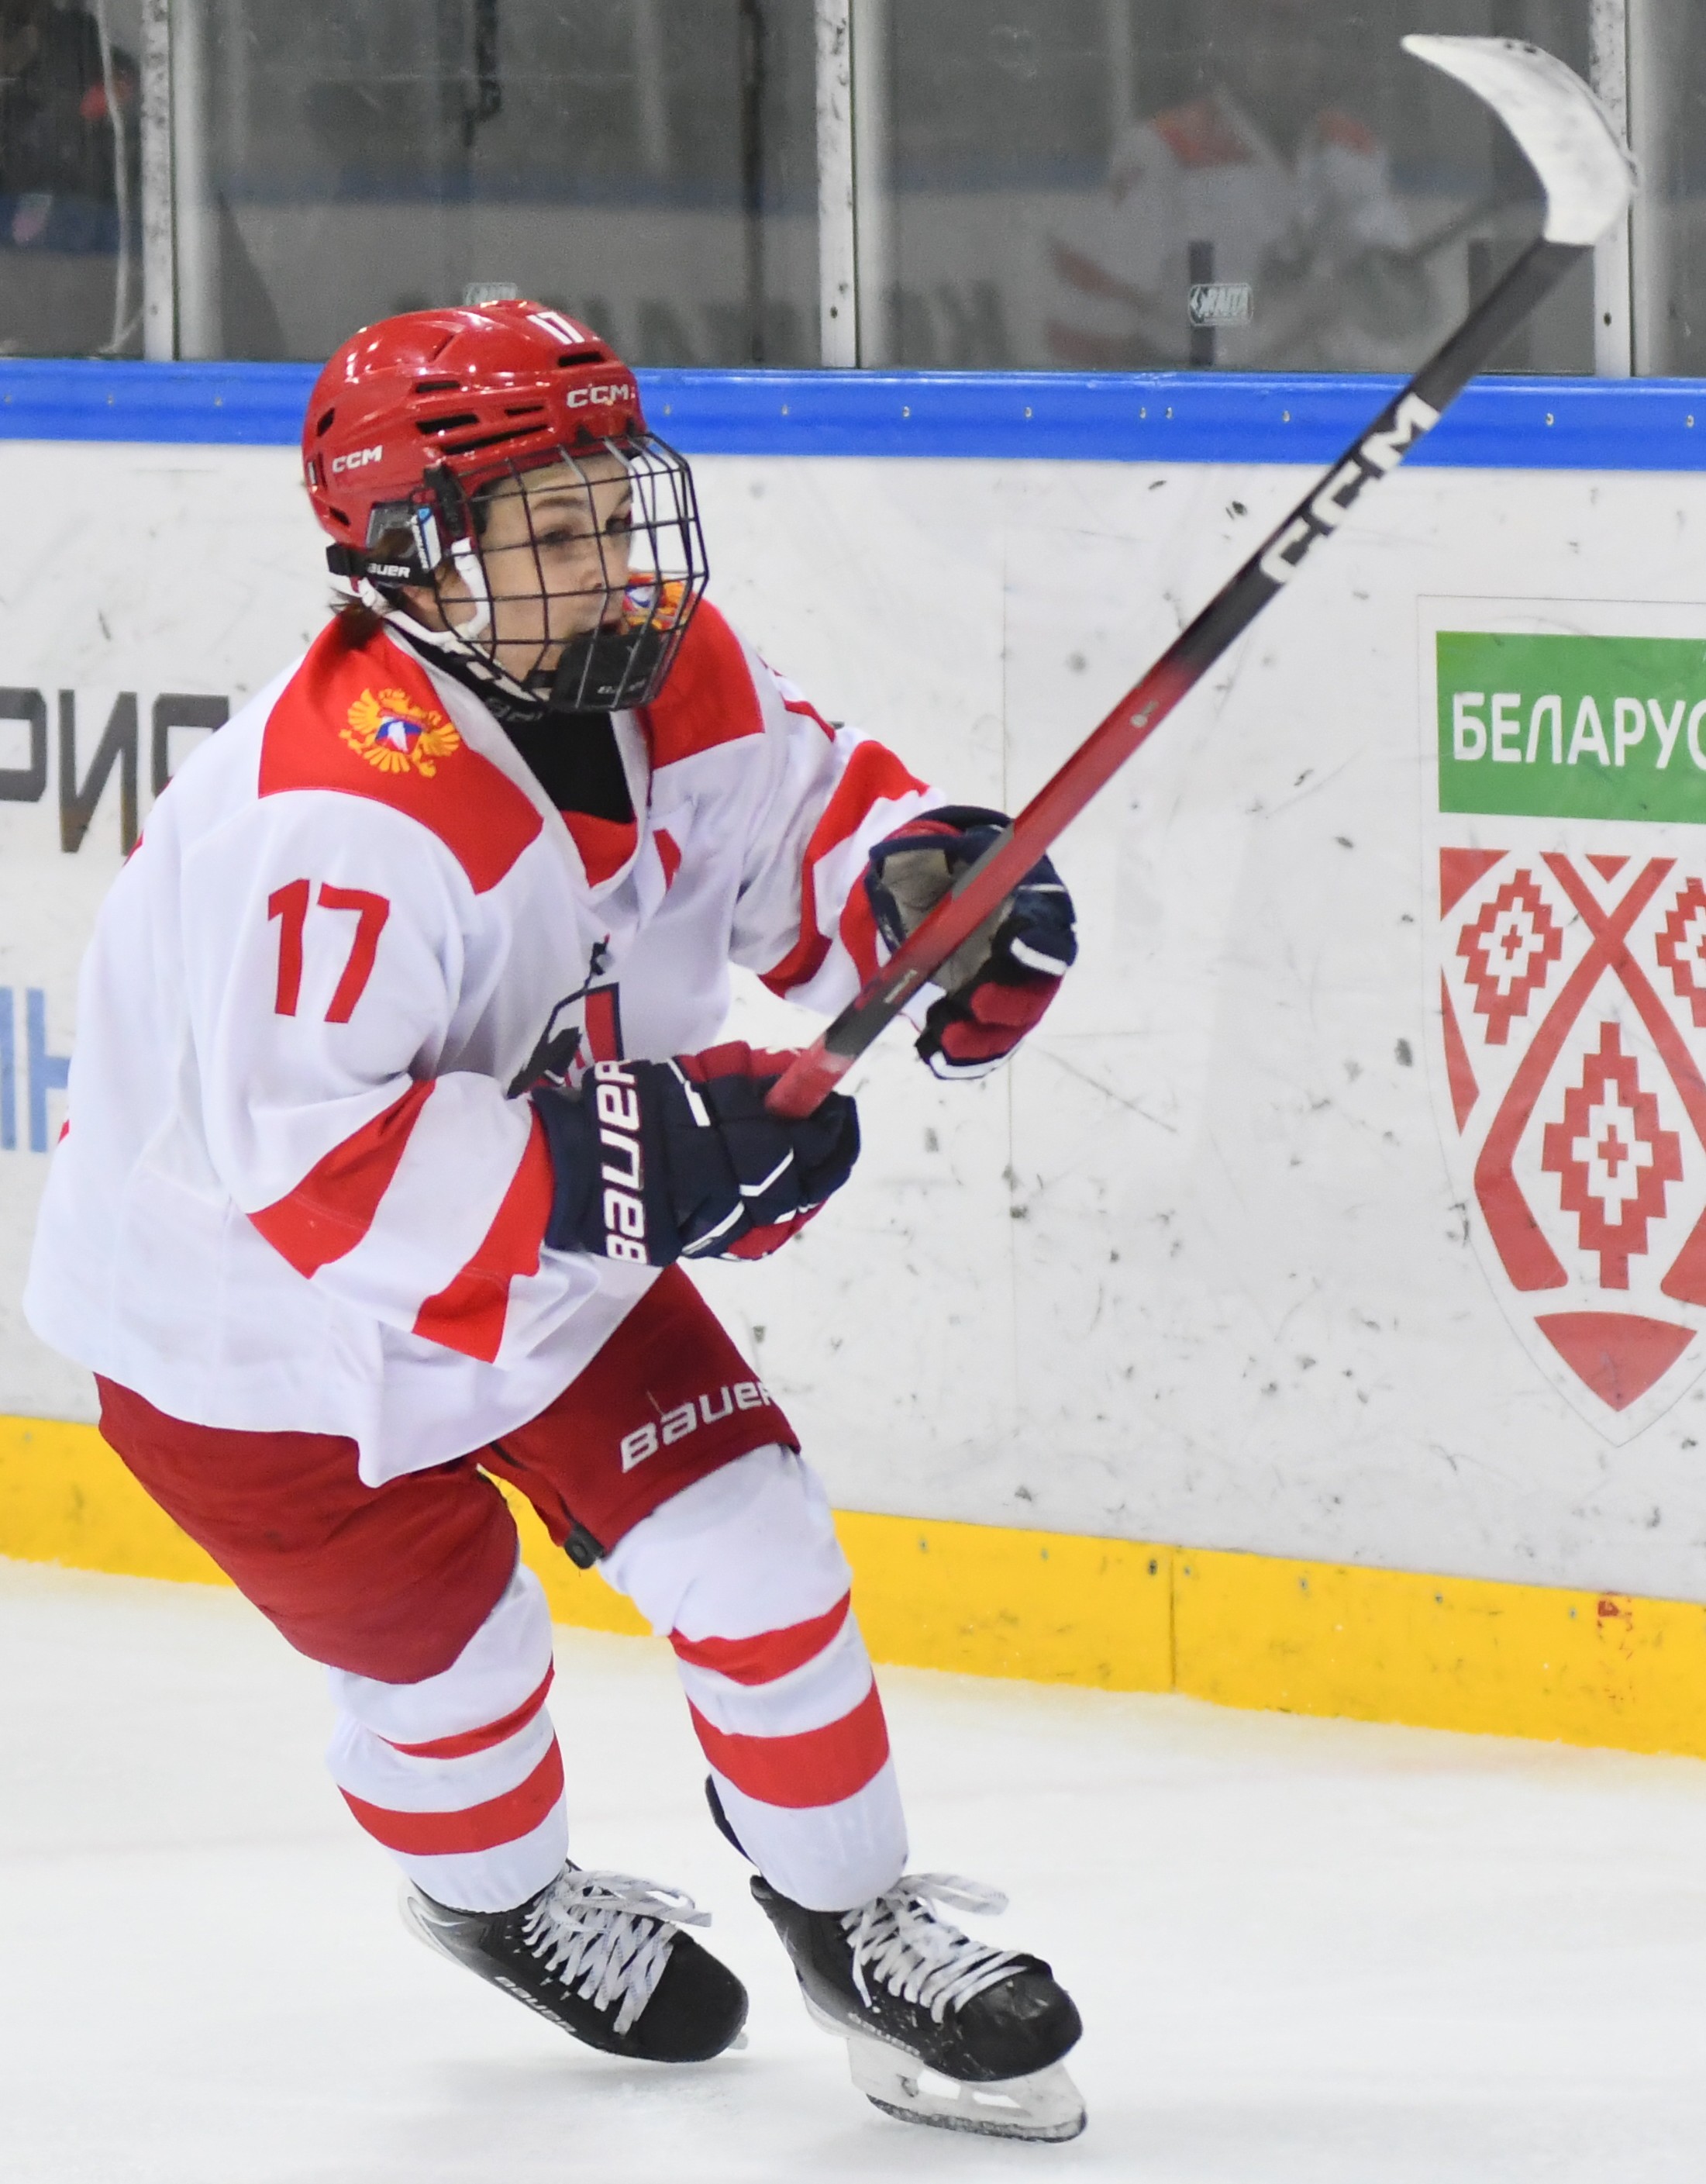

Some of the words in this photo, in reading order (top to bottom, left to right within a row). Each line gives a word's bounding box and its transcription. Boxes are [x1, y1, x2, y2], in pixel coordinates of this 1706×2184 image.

[526, 310, 586, 346] 17
[566, 383, 629, 409] CCM
[332, 445, 384, 473] CCM
[1259, 392, 1442, 582] CCM
[267, 878, 391, 1024] 17
